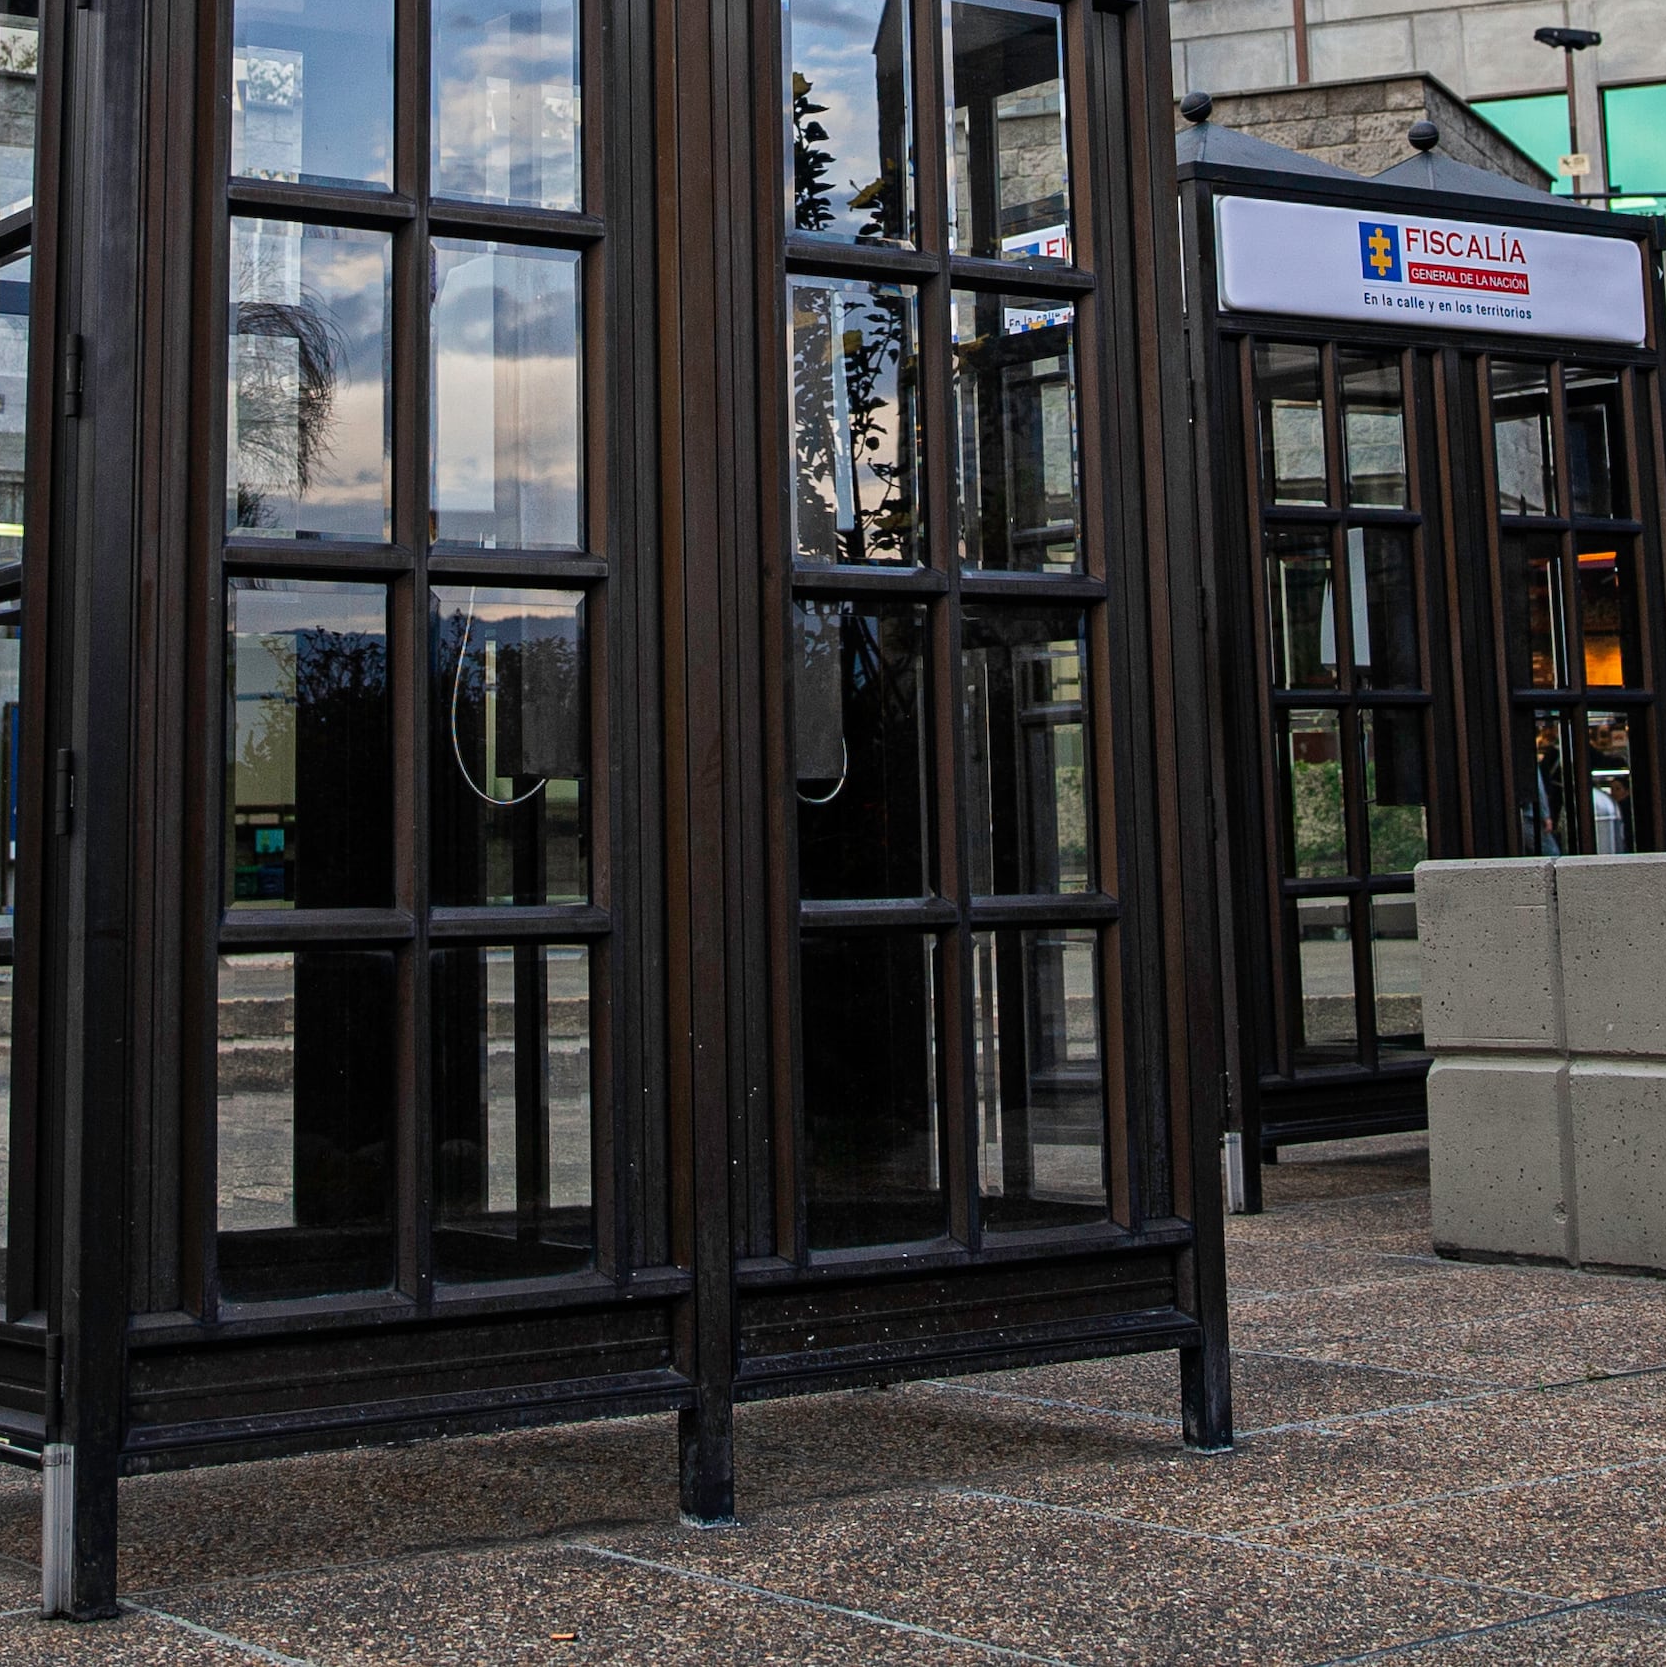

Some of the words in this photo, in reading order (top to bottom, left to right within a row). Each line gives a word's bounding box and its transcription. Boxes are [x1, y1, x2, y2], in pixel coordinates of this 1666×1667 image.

[1405, 227, 1527, 264] FISCALÍA
[1411, 267, 1458, 284] GENERAL
[1460, 272, 1474, 285] DE
[1475, 274, 1489, 286] LA
[1490, 275, 1527, 290] NACIÓN
[1364, 292, 1378, 305] En
[1383, 294, 1393, 307] la
[1397, 295, 1425, 310] calle
[1428, 300, 1435, 313] y
[1439, 300, 1452, 312] en
[1455, 300, 1473, 314] los
[1476, 303, 1532, 319] territorios
